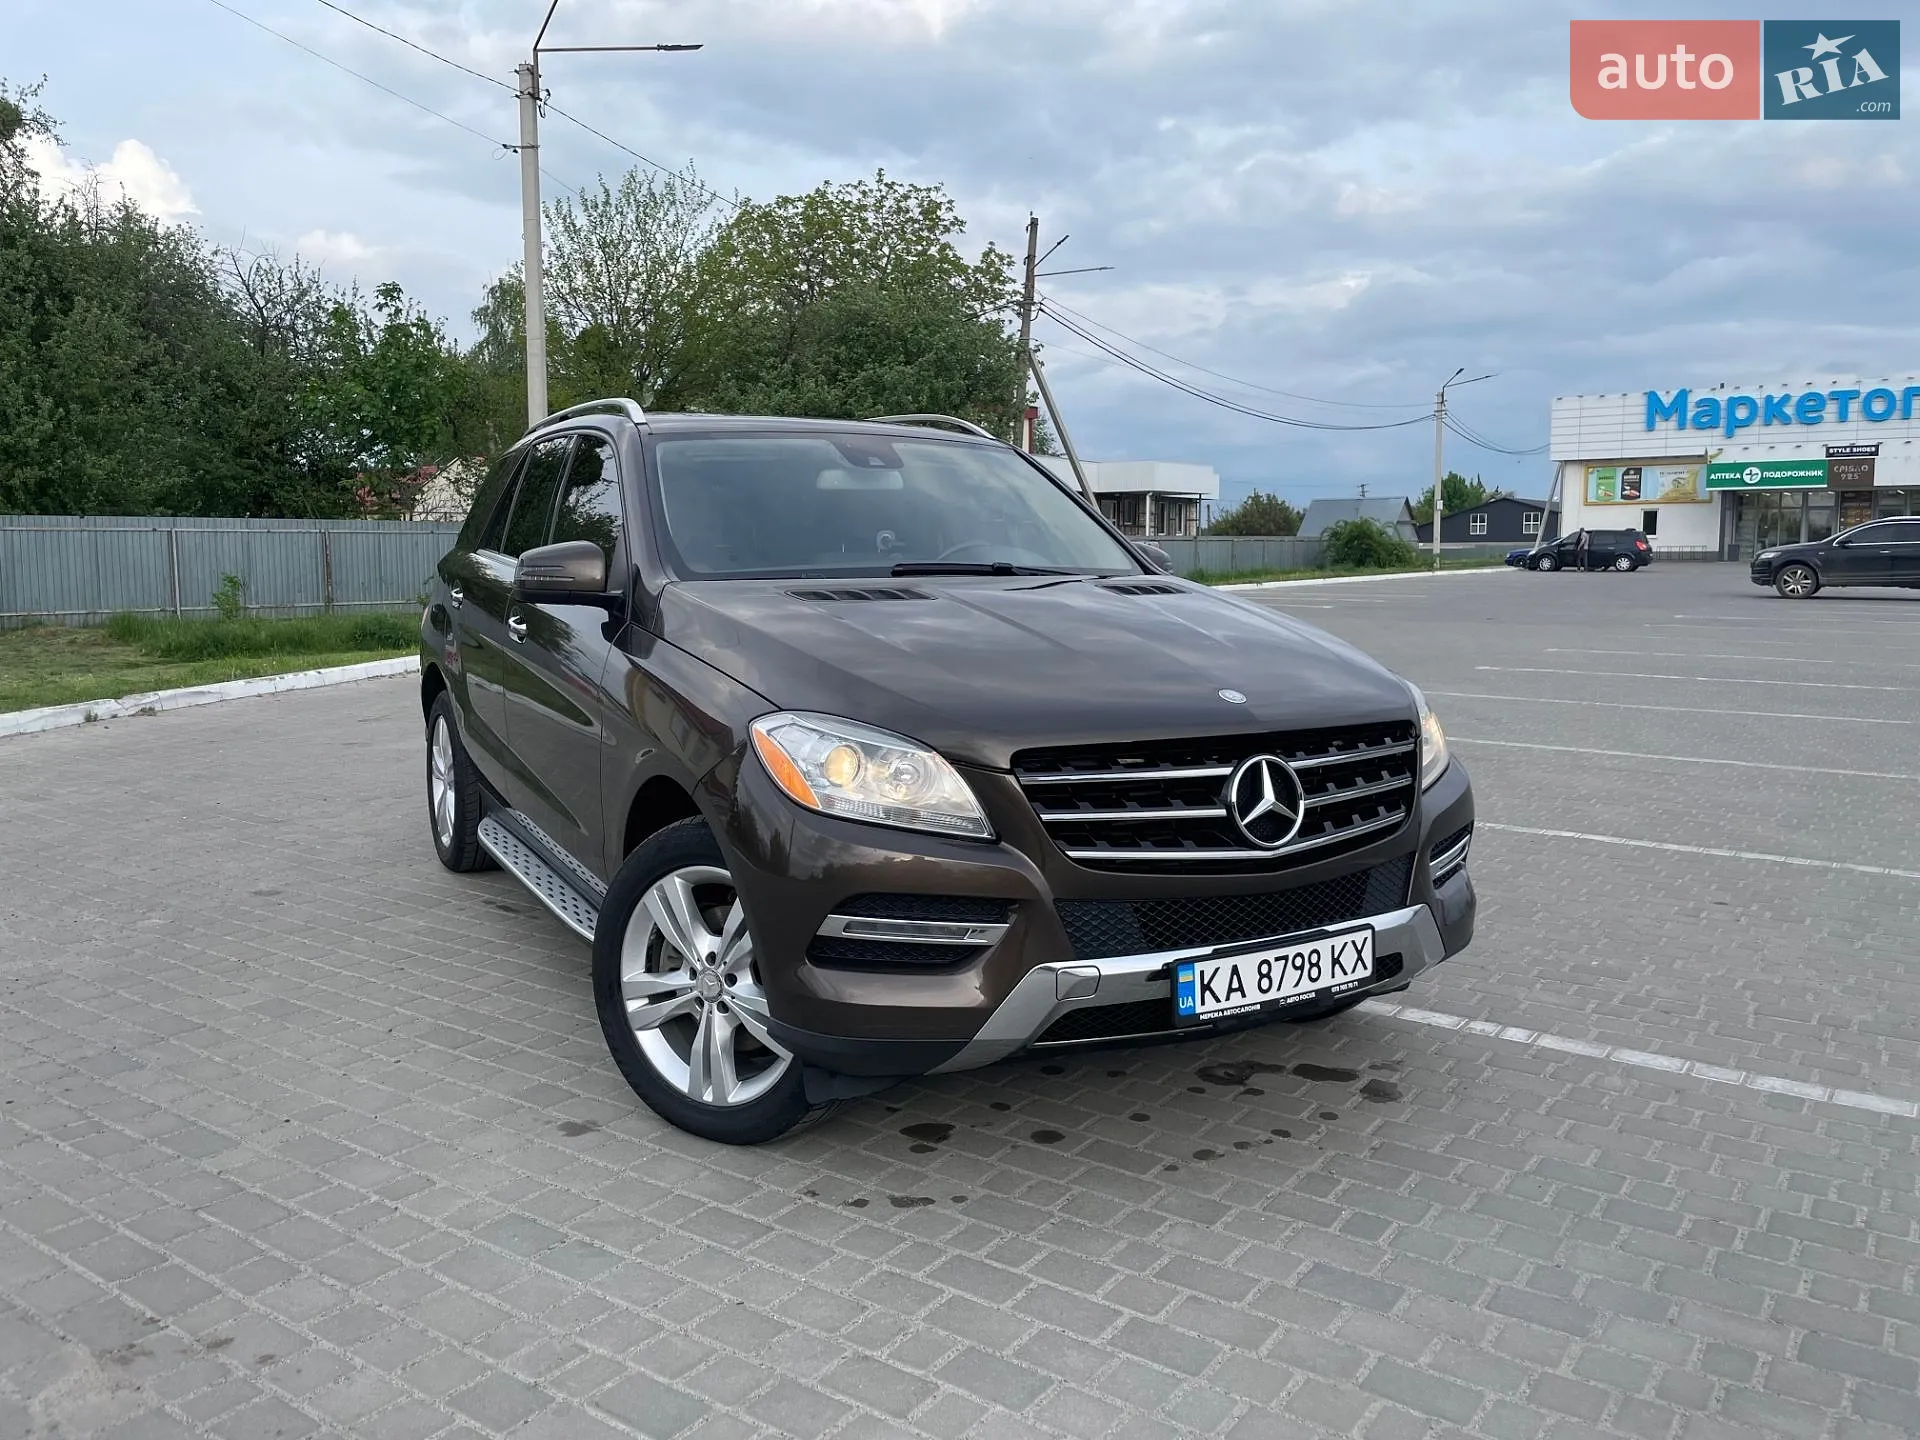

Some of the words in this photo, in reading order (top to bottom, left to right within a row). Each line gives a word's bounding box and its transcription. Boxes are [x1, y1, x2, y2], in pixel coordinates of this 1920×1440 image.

[1710, 472, 1741, 480] АПТЕКА
[1763, 470, 1823, 478] ПОДОРОЖНИК
[1200, 964, 1247, 1006] KA
[1257, 948, 1321, 994] 8798
[1331, 936, 1369, 979] KX
[1179, 996, 1194, 1009] UA
